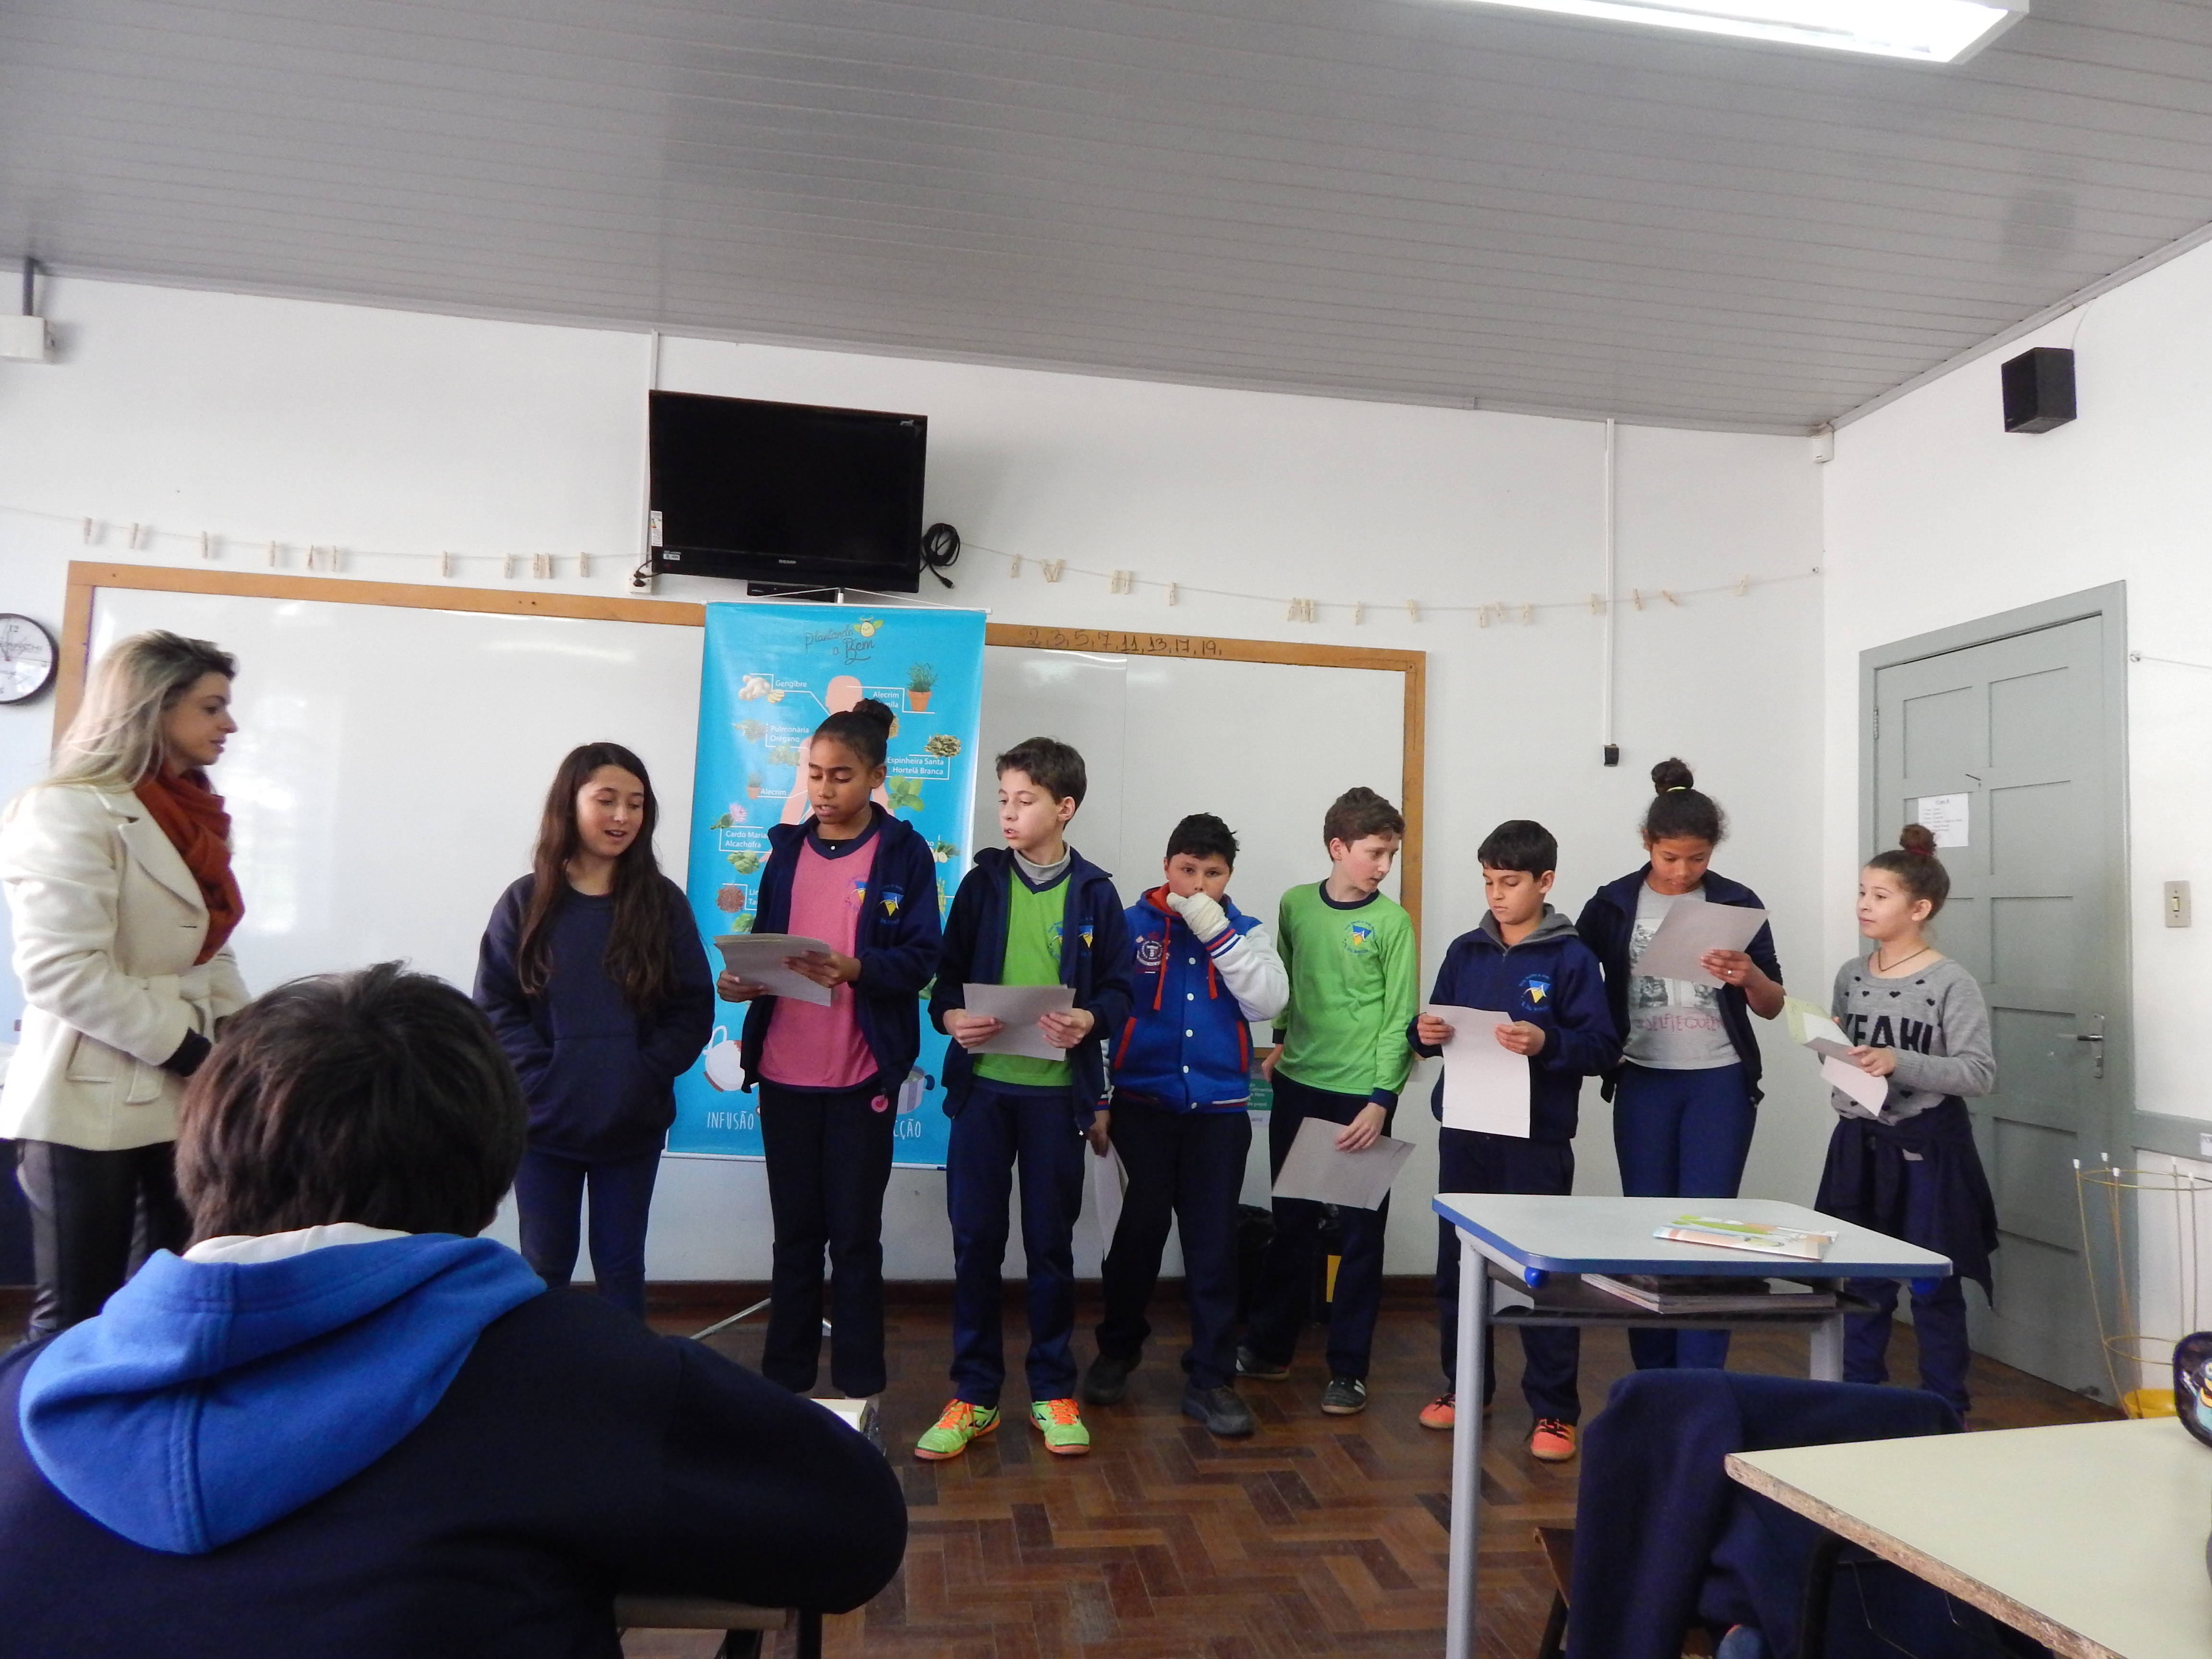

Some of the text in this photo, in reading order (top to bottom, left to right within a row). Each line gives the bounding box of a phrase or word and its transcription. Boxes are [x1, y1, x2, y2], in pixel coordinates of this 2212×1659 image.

[775, 680, 807, 688] Gengibre
[771, 725, 809, 733] Pulmonária
[770, 735, 800, 743] Orégano
[707, 1110, 754, 1130] INFUSÃO
[893, 1118, 921, 1140] CÇÃO
